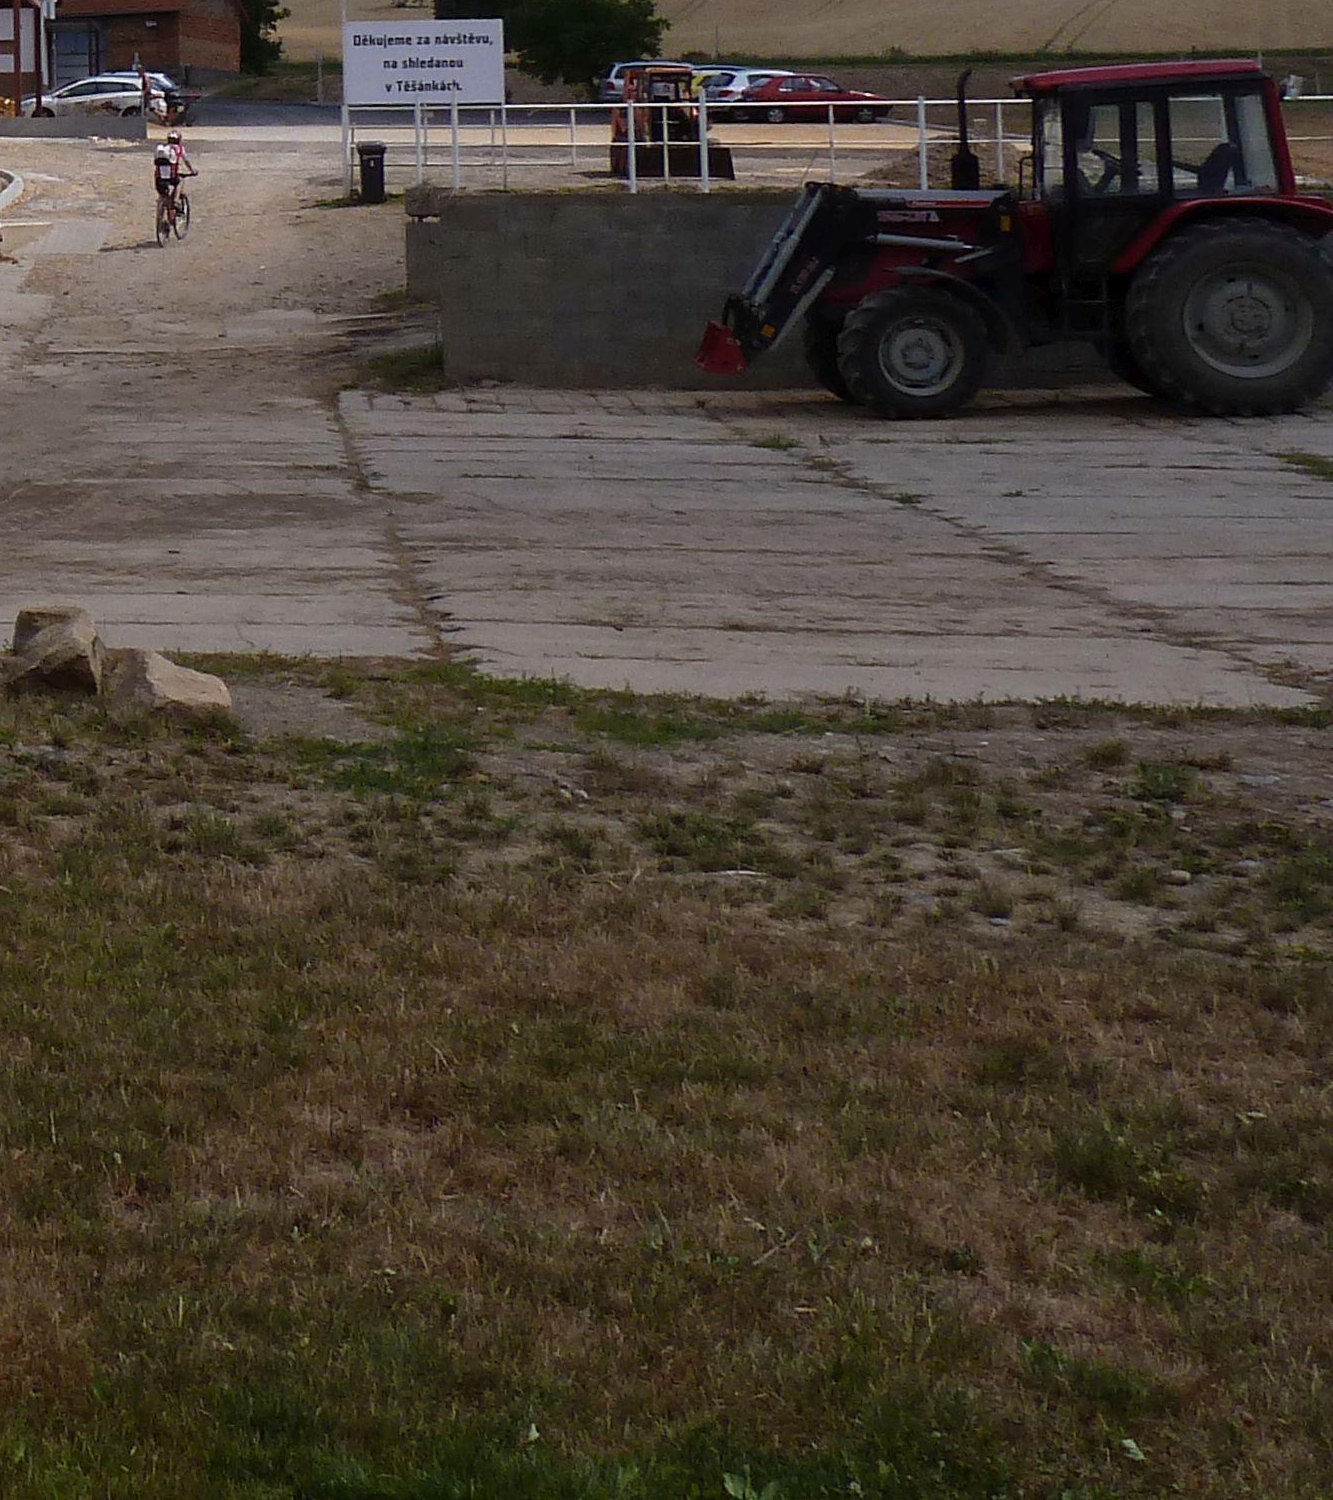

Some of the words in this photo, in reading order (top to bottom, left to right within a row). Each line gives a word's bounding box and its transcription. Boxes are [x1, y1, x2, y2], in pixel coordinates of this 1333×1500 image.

[353, 34, 412, 48] Děkujeme
[416, 36, 430, 45] za
[435, 33, 493, 46] návštěvu,
[383, 59, 397, 69] na
[402, 57, 464, 69] shledanou
[385, 83, 392, 92] v
